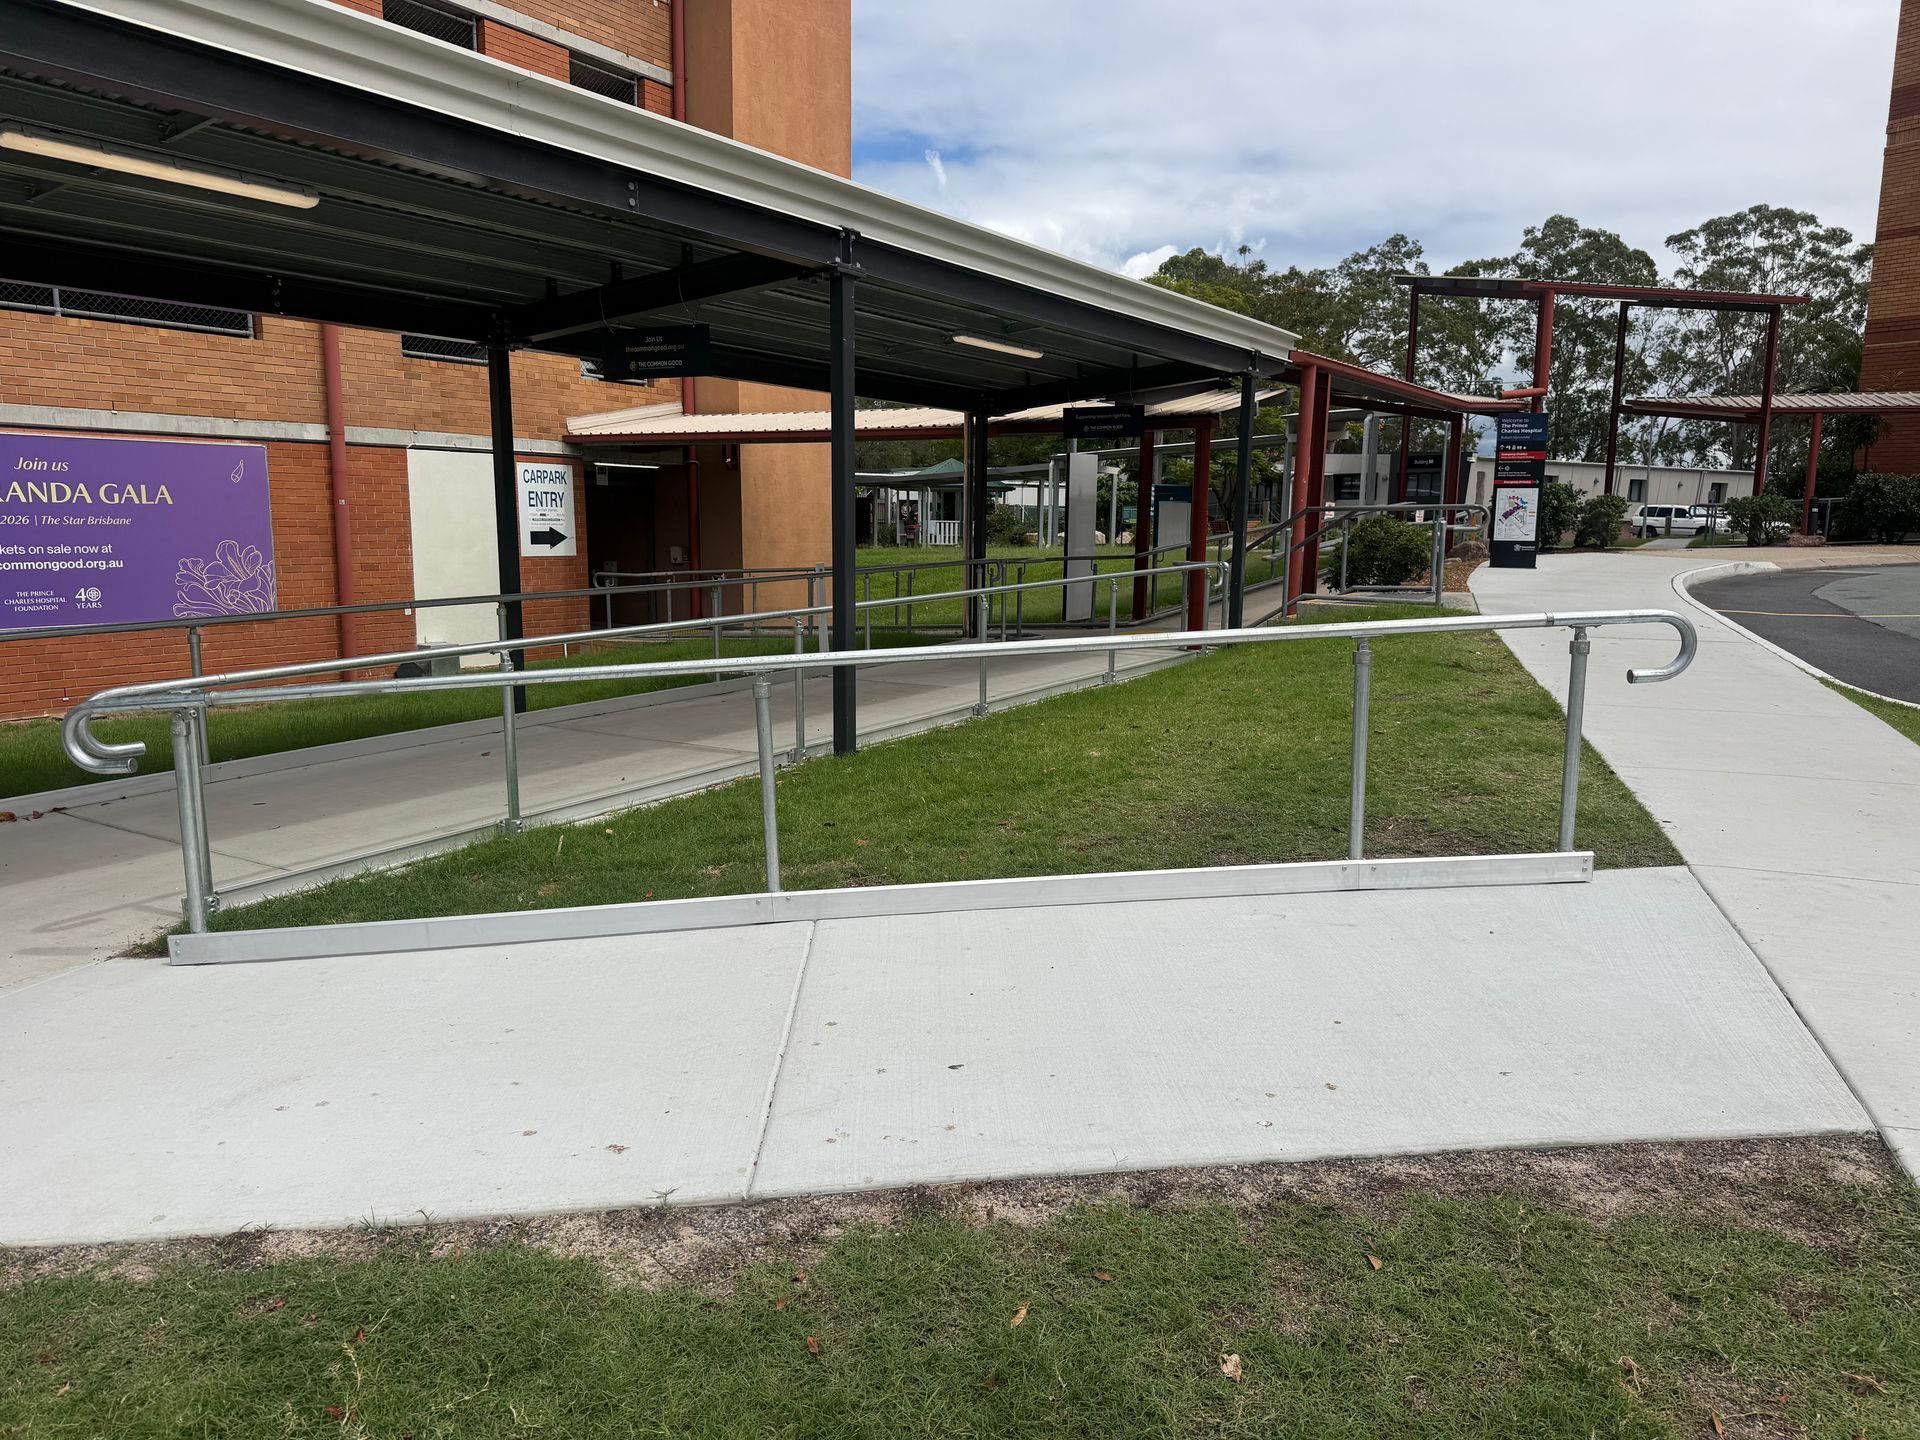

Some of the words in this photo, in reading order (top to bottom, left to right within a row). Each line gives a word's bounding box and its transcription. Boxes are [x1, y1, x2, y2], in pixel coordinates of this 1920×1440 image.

[14, 457, 48, 471] Join
[51, 460, 69, 472] us
[523, 468, 567, 485] CARPARK
[0, 481, 93, 504] ANDA
[99, 483, 174, 505] GALA
[528, 490, 564, 508] ENTRY
[0, 515, 30, 525] 2026
[41, 515, 61, 525] The
[62, 515, 86, 525] Star
[87, 516, 132, 526] Brisbane
[28, 546, 44, 555] on
[47, 544, 72, 554] sale
[74, 544, 99, 554] now
[101, 543, 113, 554] at
[35, 596, 67, 604] HOSPITAL
[14, 604, 59, 612] FOUNDATION
